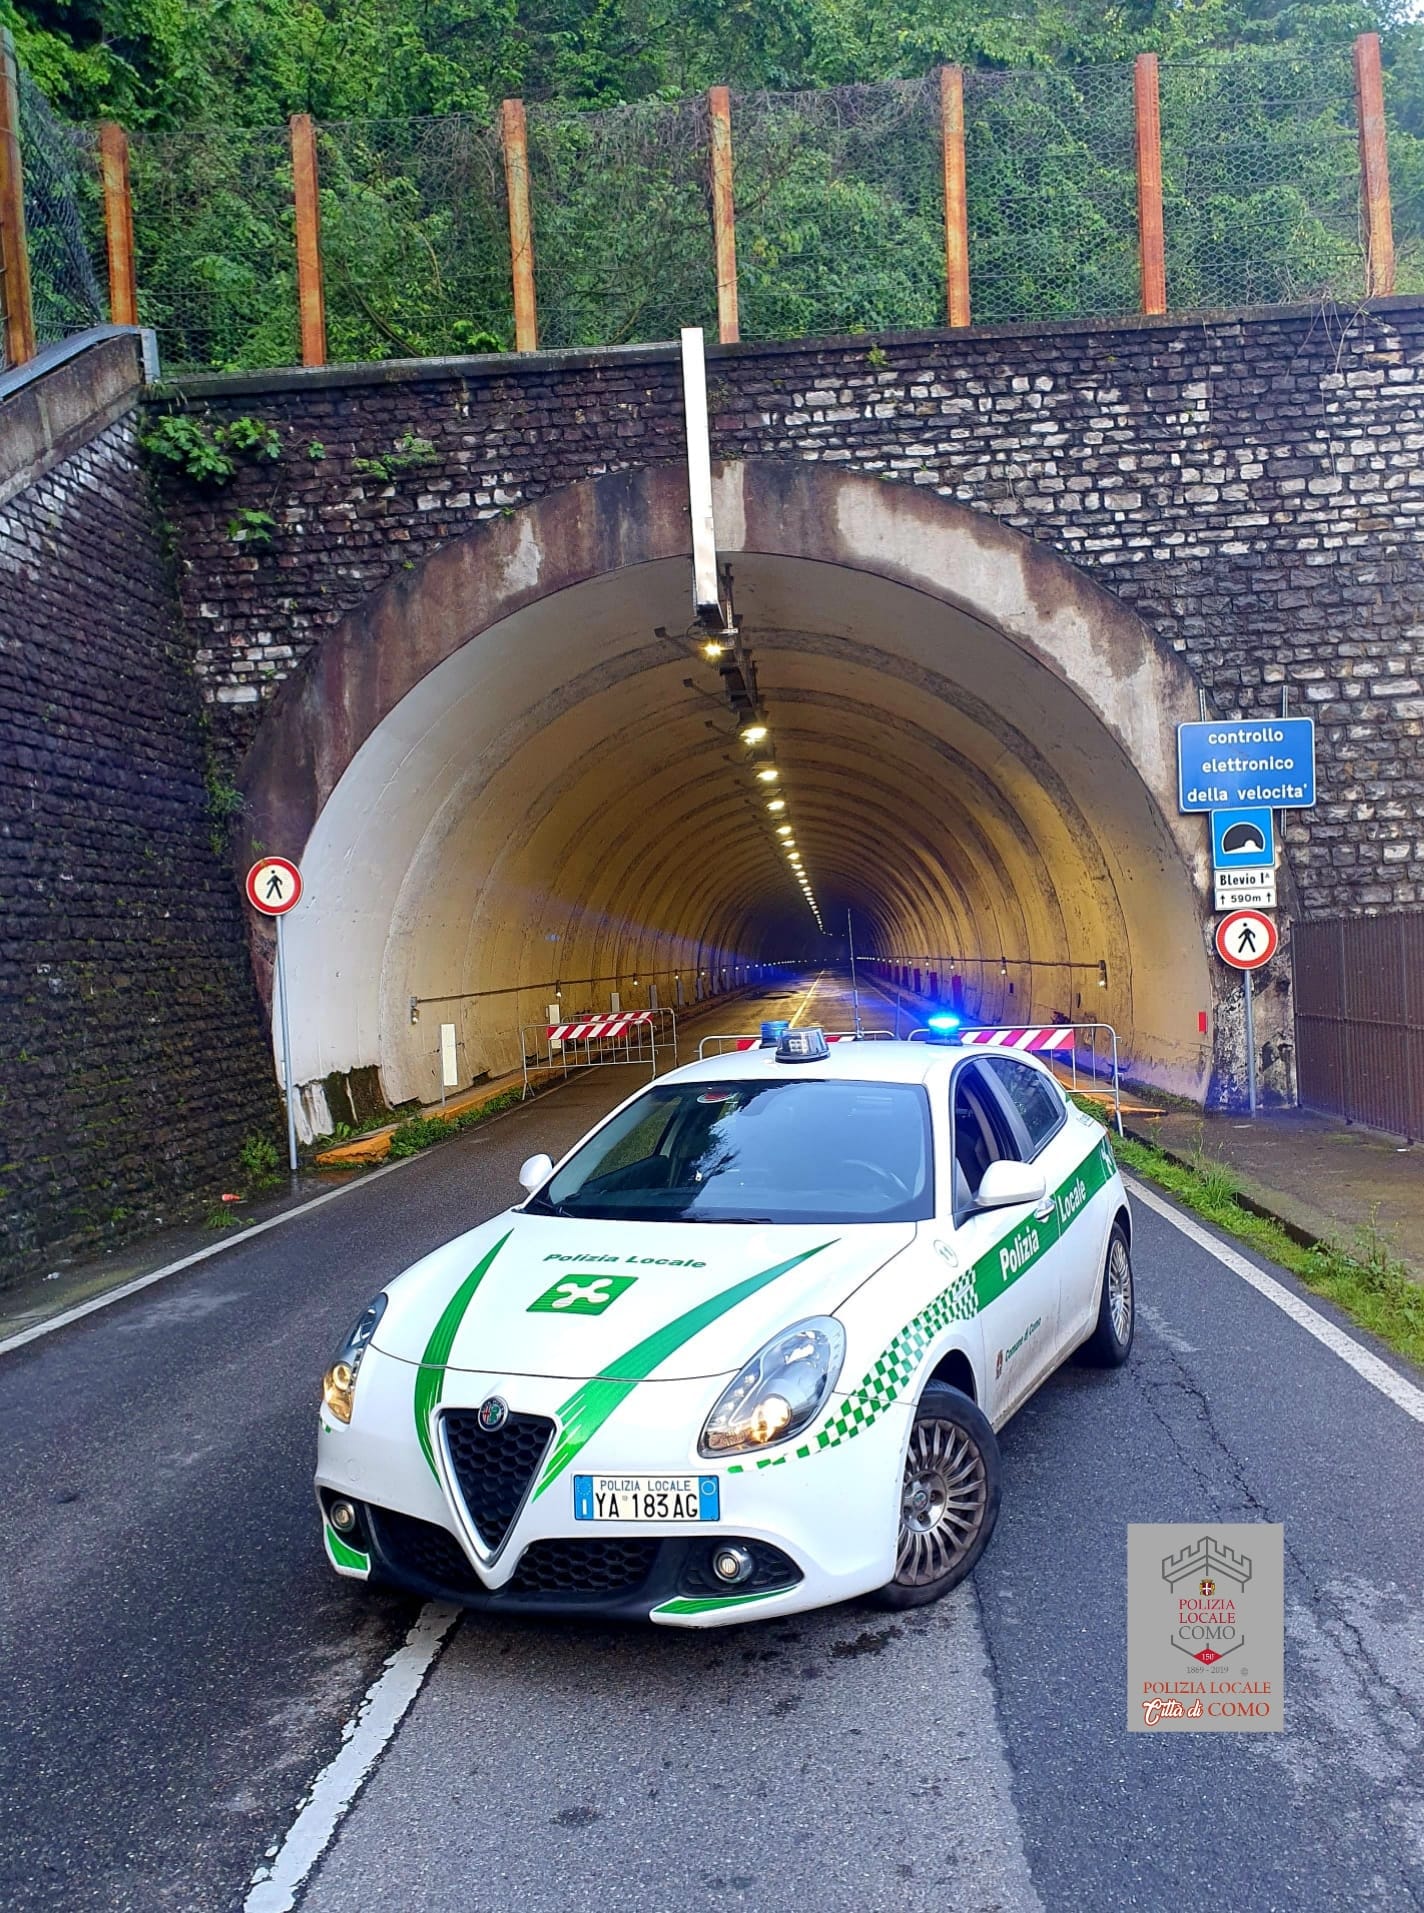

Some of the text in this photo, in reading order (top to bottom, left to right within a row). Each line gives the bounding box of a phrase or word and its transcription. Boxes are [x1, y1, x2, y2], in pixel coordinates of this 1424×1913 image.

[1208, 728, 1284, 745] controllo
[1202, 756, 1294, 773] elettronico
[1188, 784, 1308, 802] della velocita'
[1219, 873, 1256, 886] Blevio
[1230, 894, 1262, 903] 590m
[1000, 1179, 1087, 1281] Polizia Locale
[543, 1253, 707, 1268] Polizia Locale
[600, 1480, 691, 1491] POLIZIA LOCALE
